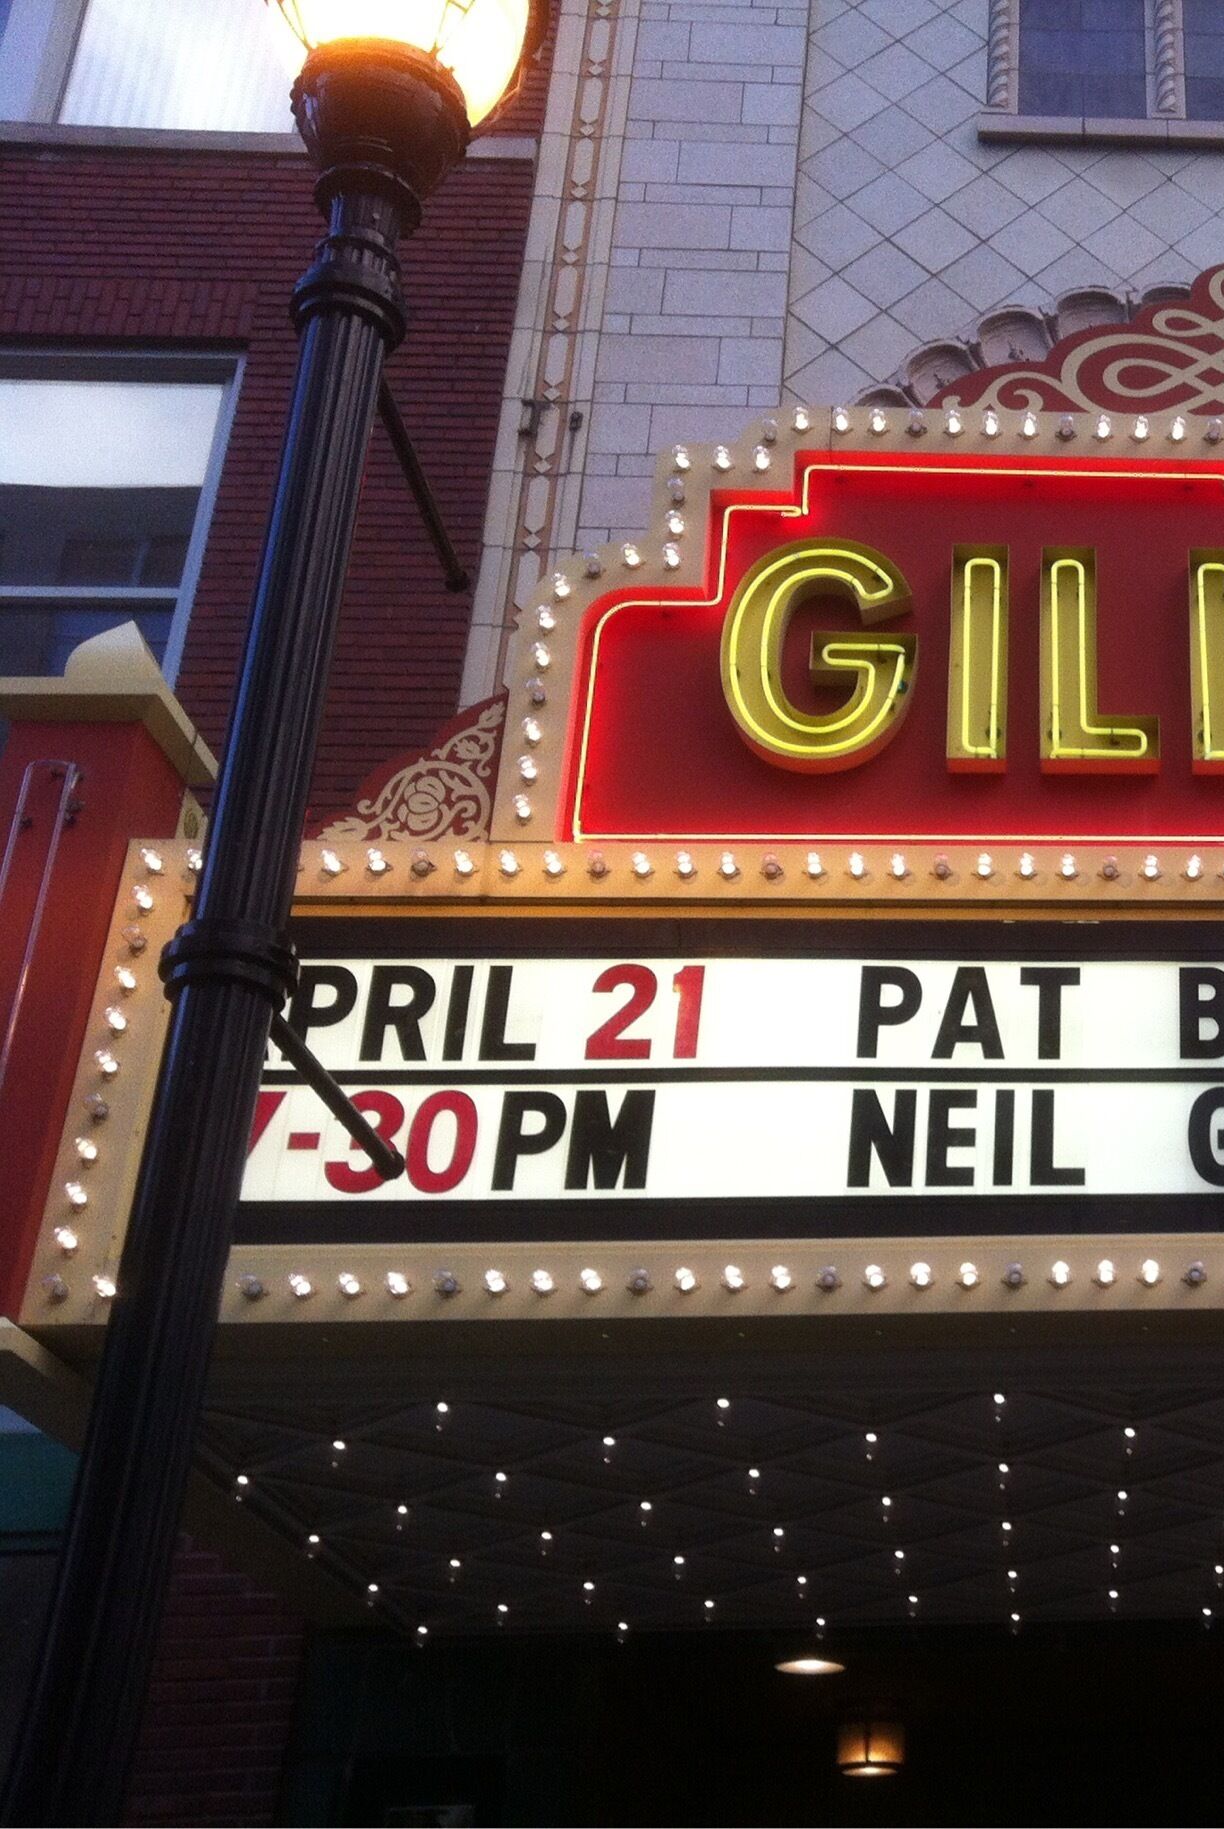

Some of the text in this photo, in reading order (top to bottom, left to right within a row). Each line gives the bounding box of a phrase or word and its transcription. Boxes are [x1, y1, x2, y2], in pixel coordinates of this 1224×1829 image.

[264, 964, 705, 1061] PRIL 21
[856, 966, 1080, 1059] PAT
[847, 1089, 1085, 1187] NEIL
